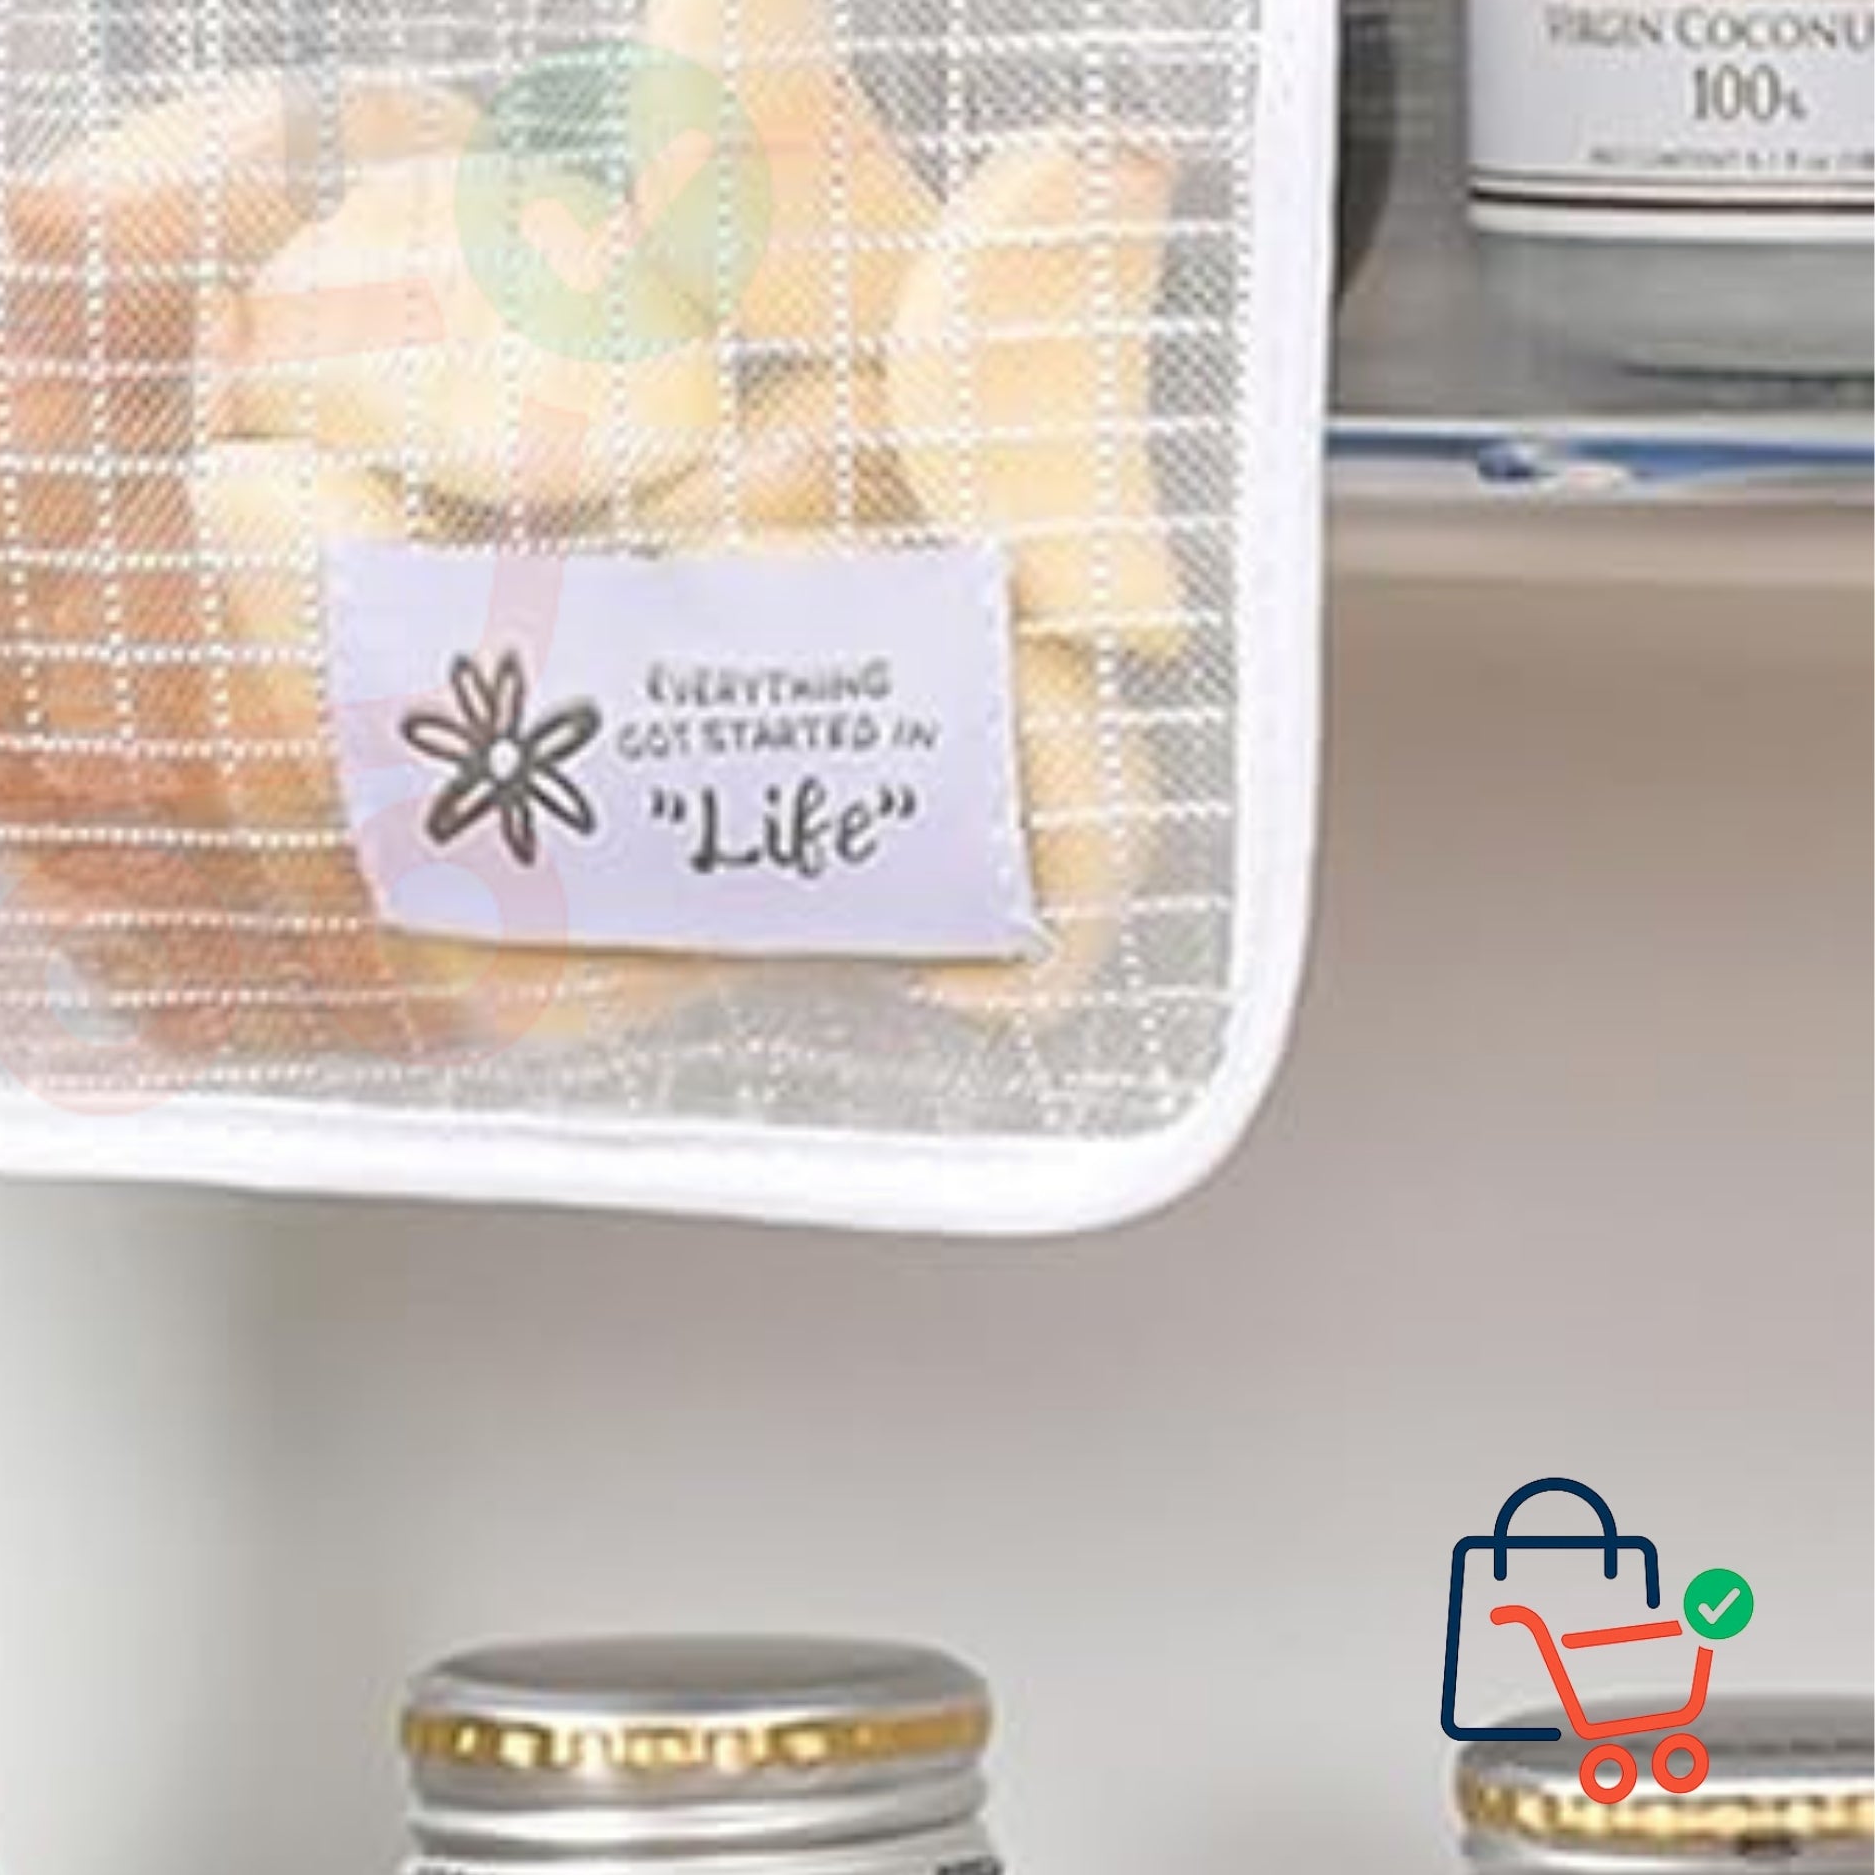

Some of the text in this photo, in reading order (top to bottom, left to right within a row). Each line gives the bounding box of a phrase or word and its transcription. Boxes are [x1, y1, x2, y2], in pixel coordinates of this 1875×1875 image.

[646, 659, 890, 705] EVERYTHING
[618, 712, 938, 761] GOT STARTED IN
